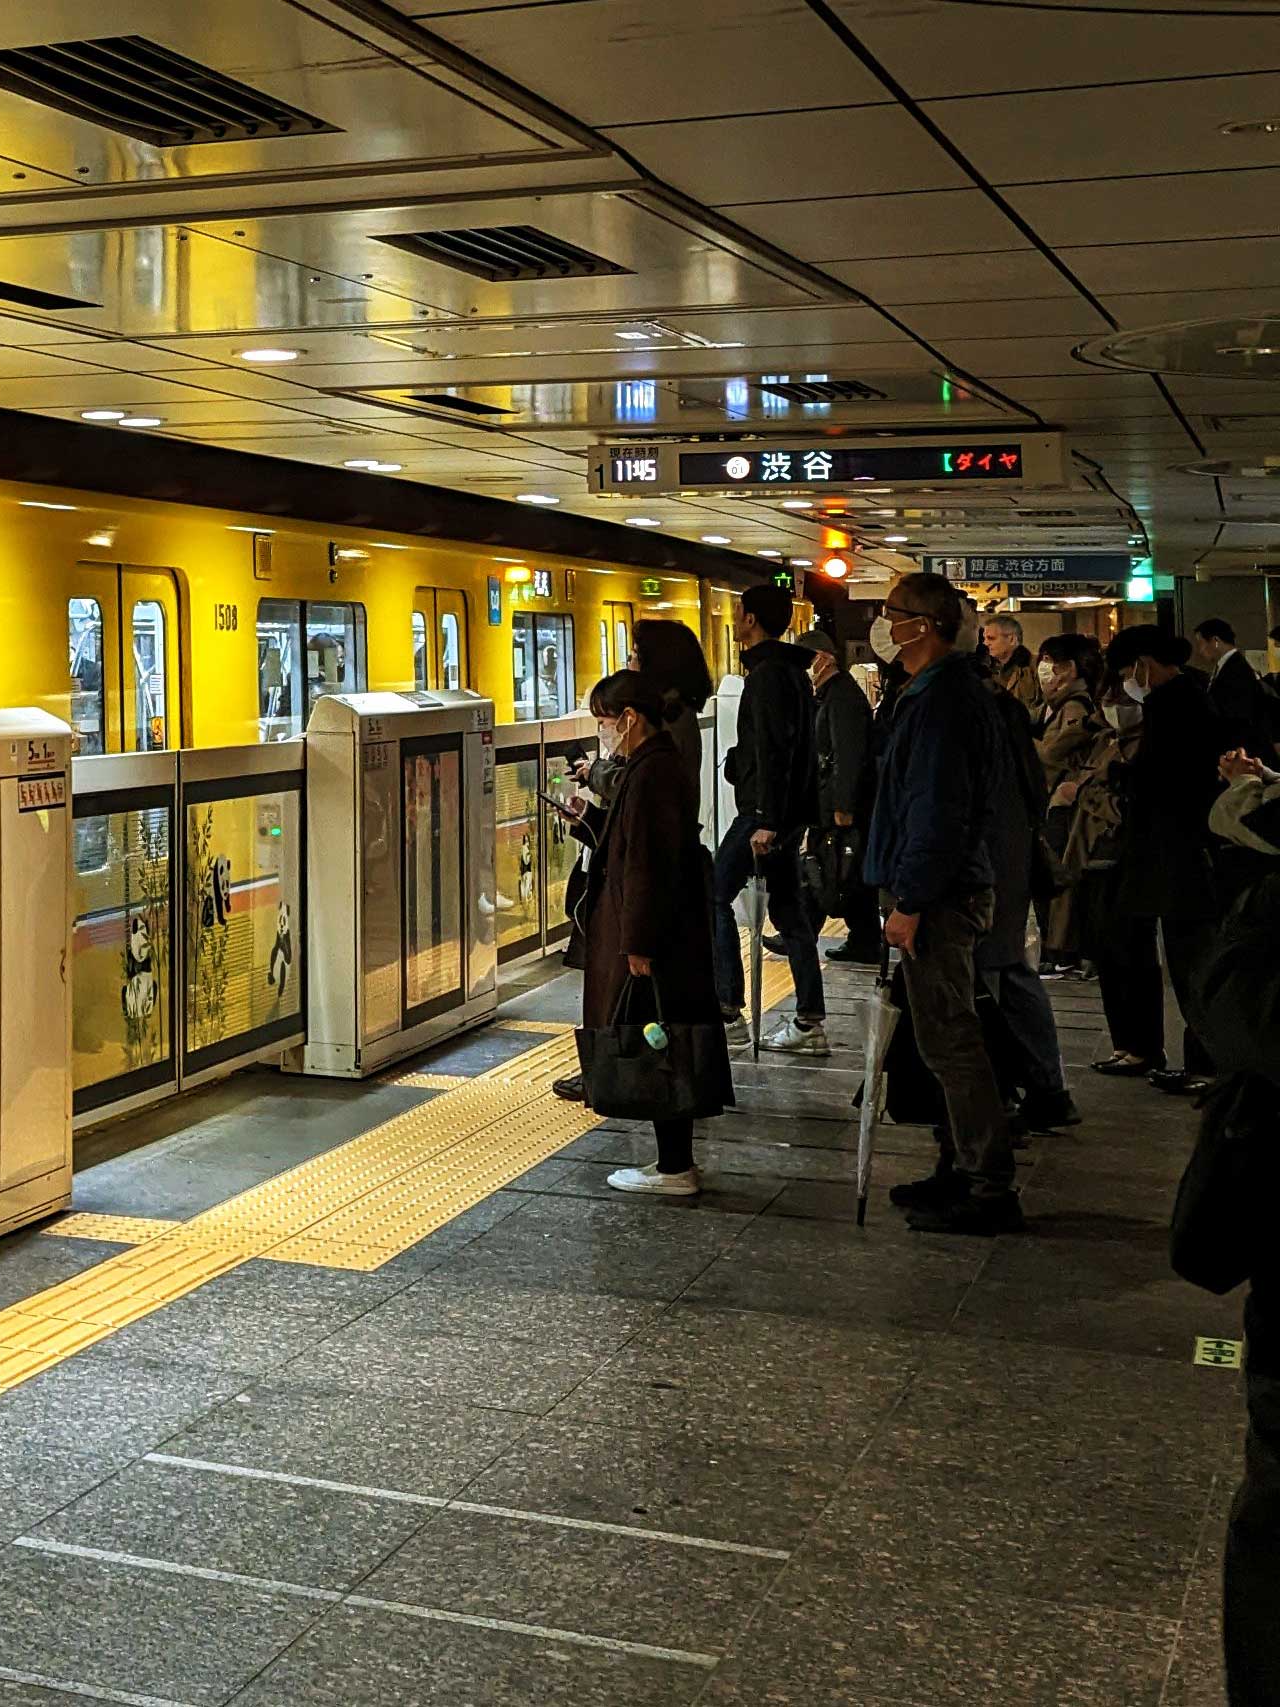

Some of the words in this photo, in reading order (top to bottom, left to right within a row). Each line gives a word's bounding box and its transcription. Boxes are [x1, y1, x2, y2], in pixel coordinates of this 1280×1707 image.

[594, 464, 604, 490] 1
[761, 452, 833, 481] 渋谷
[215, 603, 237, 631] 1508
